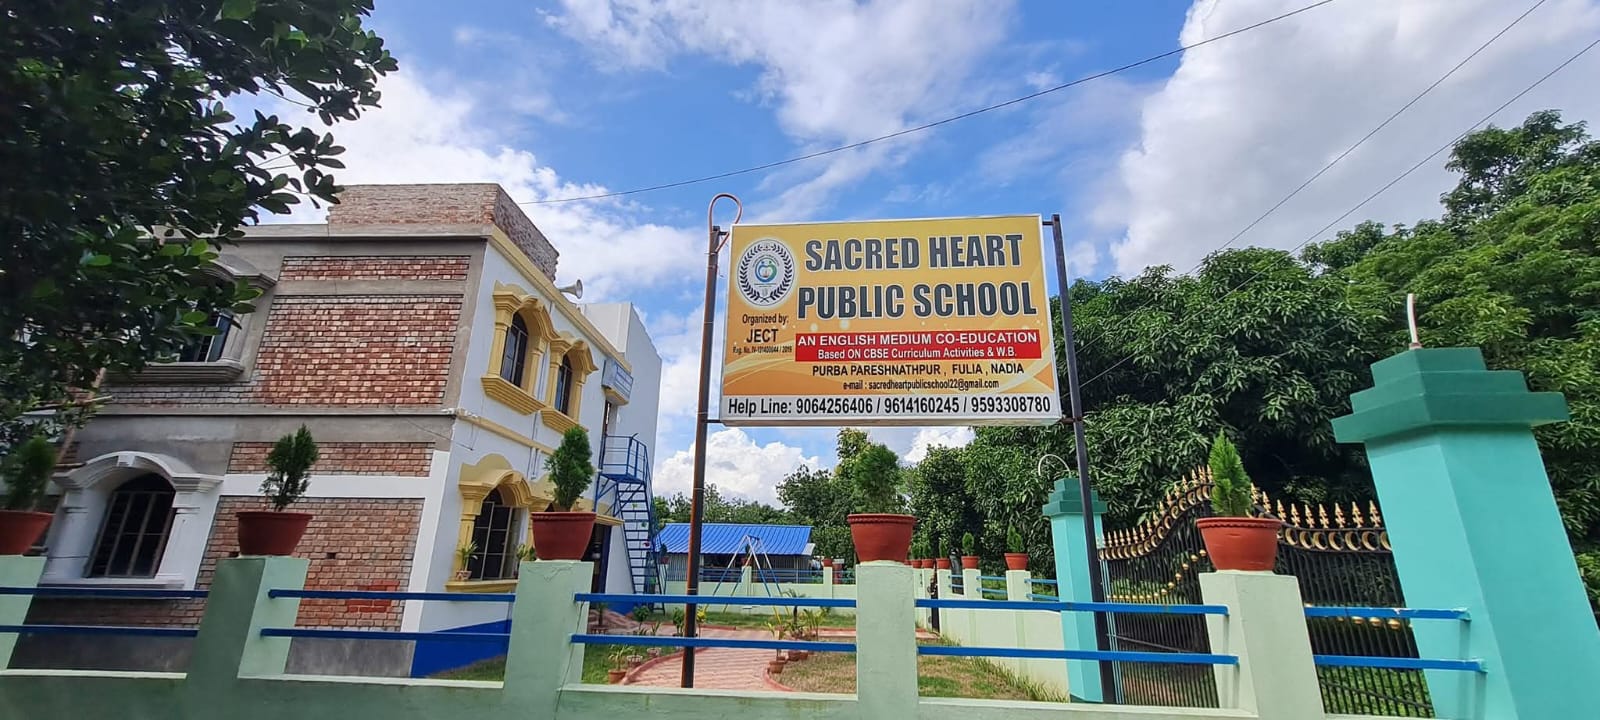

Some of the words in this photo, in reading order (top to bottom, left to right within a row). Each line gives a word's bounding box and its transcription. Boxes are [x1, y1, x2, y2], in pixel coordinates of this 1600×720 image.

[805, 237, 920, 272] SACRED
[929, 234, 1023, 268] HEART
[798, 285, 904, 319] PUBLIC
[913, 281, 1037, 317] SCHOOL
[742, 313, 777, 326] Organized
[778, 312, 789, 325] by:
[746, 328, 779, 343] JECT
[798, 336, 816, 346] AN
[820, 334, 876, 346] ENGLISH
[880, 333, 932, 345] MEDIUM
[935, 332, 1037, 344] CO-EDUCATION
[818, 349, 845, 359] Based
[847, 349, 861, 358] ON
[864, 349, 889, 358] CBSE
[891, 347, 941, 358] Curriculum
[943, 347, 984, 357] Activities
[987, 347, 994, 357] &
[996, 346, 1017, 357] W.B.
[812, 365, 848, 376] PURBA
[850, 364, 941, 376] PARESHNATHPUR
[952, 363, 983, 375] FULIA
[991, 363, 1025, 374] NADIA
[843, 380, 863, 390] e-mail
[868, 378, 999, 391] sacredheartpublicschool22@gmail.com
[728, 398, 757, 417] Help
[760, 398, 792, 414] Line:
[796, 398, 873, 414] 9064256406
[884, 396, 960, 414] 9614160245
[971, 396, 1051, 413] 9593308780
